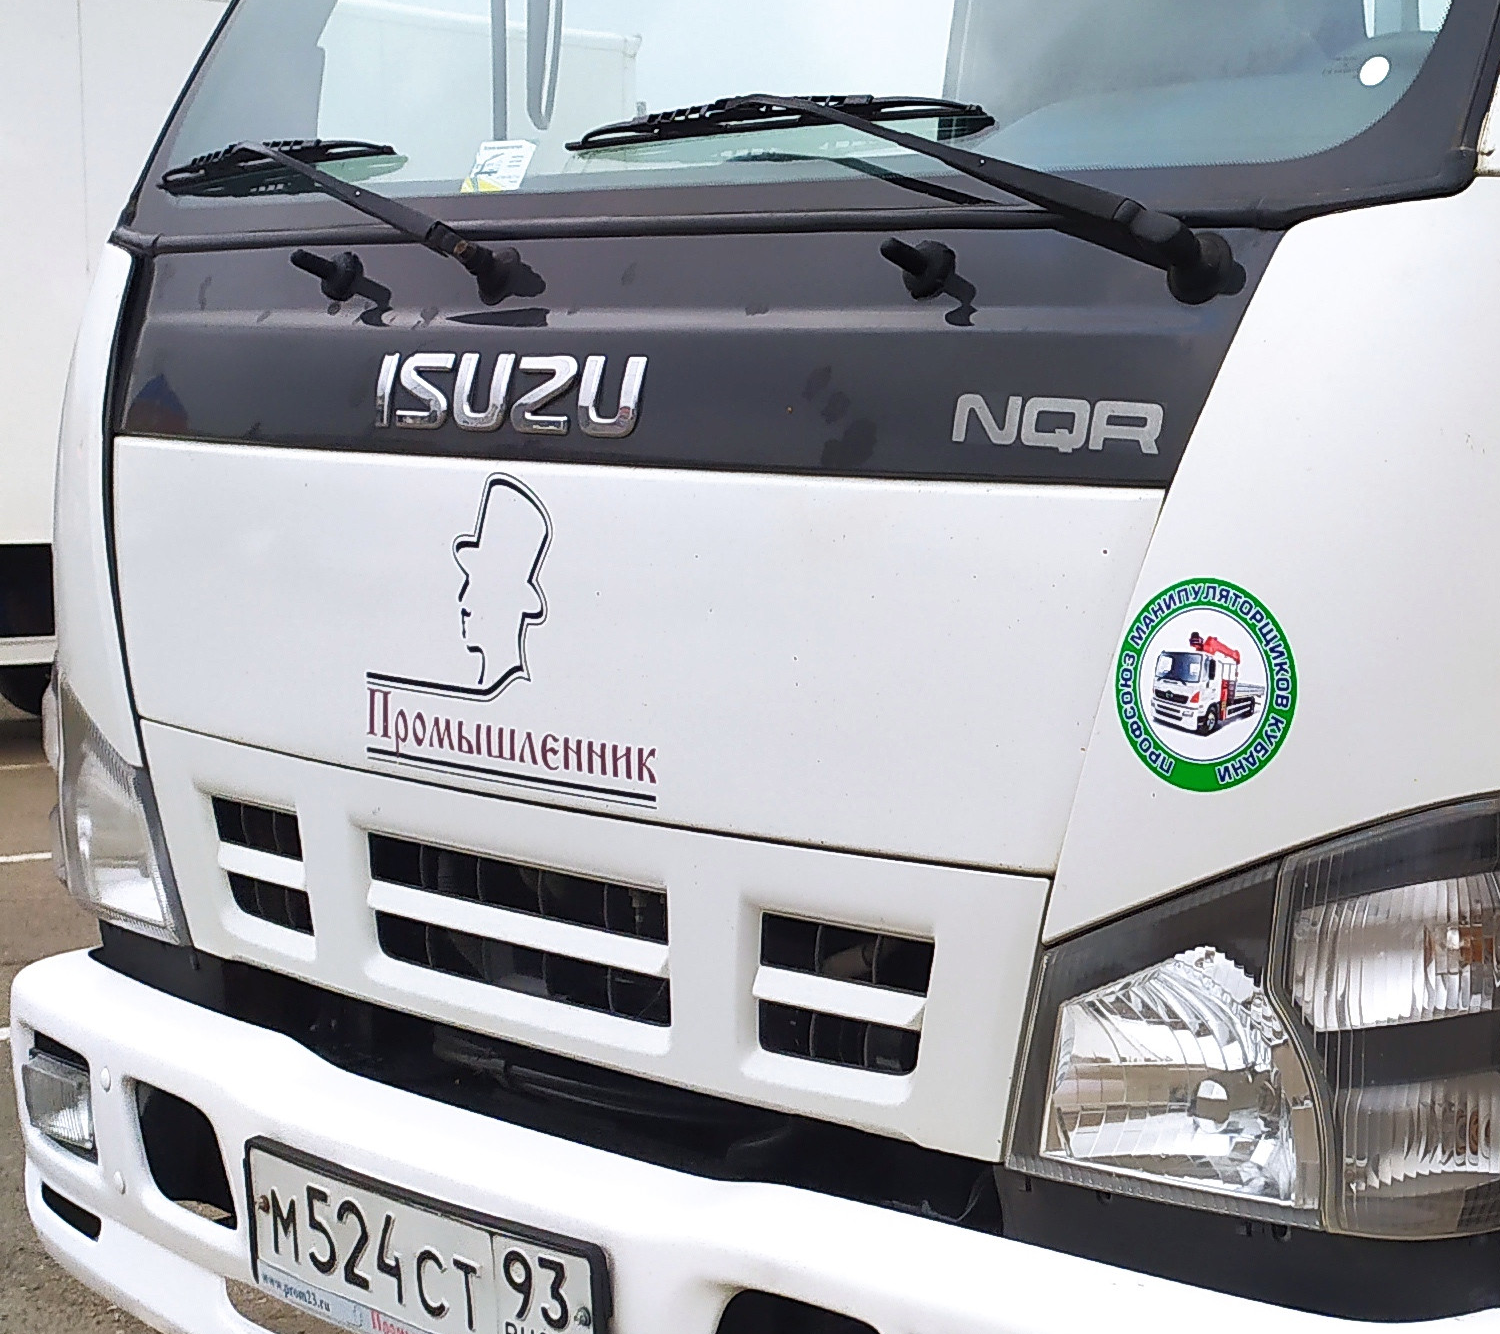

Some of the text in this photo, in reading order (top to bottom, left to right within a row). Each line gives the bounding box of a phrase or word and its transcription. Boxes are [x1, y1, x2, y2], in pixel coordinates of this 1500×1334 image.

[376, 351, 649, 439] ISUZU
[951, 393, 1164, 455] NQR
[1119, 584, 1290, 784] ПРОФСОЮЗ МАНИПУЛЯТОРЩИКОВ КУБАНИ
[366, 688, 657, 783] Промышленник
[262, 1273, 332, 1313] www.prom23.ru
[503, 1249, 570, 1331] 93
